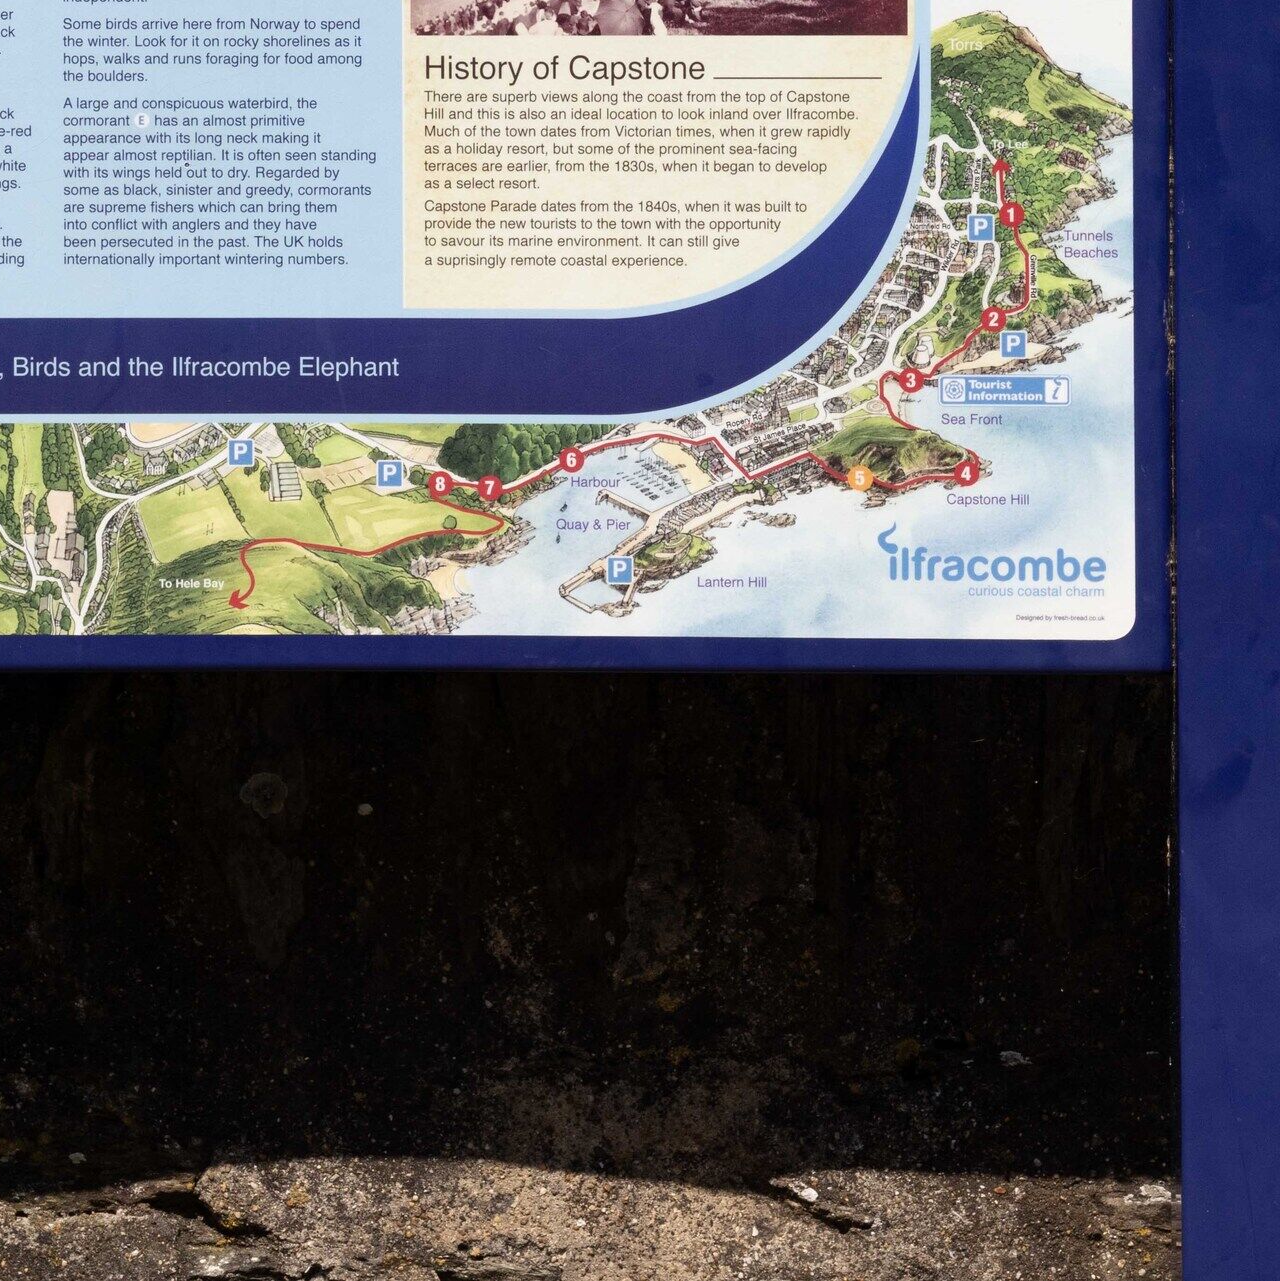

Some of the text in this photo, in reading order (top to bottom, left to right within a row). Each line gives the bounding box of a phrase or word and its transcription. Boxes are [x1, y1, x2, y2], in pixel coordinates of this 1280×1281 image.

[948, 38, 983, 51] Torrs
[425, 54, 706, 87] History of Capstone
[423, 90, 850, 106] There are superb views along the coast from the top of Capstone
[992, 139, 1005, 150] To
[1007, 208, 1015, 223] 1
[973, 221, 988, 236] P
[1063, 229, 1114, 242] Tunnels
[63, 252, 349, 268] internationally important wintering numbers.
[1064, 246, 1119, 259] Beaches
[424, 253, 687, 269] a suprisingly remote coastal experience.
[989, 312, 999, 326] 2
[1006, 338, 1021, 352] P
[13, 356, 71, 377] Birds
[78, 356, 120, 377] and
[127, 356, 164, 377] the
[172, 356, 291, 377] Ilfracombe
[299, 356, 400, 382] Elephant
[905, 372, 917, 389] 3
[968, 379, 1013, 390] Tourist
[968, 391, 1043, 402] Information
[941, 413, 1004, 427] Sea Front
[233, 443, 248, 460] P
[566, 452, 577, 468] 6
[382, 464, 397, 481] P
[854, 470, 865, 486] 5
[960, 465, 972, 482] 4
[435, 476, 446, 491] 8
[486, 480, 495, 495] 7
[570, 475, 621, 489] Harbour
[946, 493, 1030, 508] Capstone Hill
[555, 518, 631, 532] Quay & Pier
[877, 522, 1107, 582] ilfracombe
[612, 560, 627, 577] P
[159, 578, 225, 591] To Hele Bay
[697, 576, 767, 588] Lantern Hill
[968, 583, 1105, 599] curious coastal charm
[1015, 614, 1044, 622] Designed
[1045, 614, 1053, 622] by
